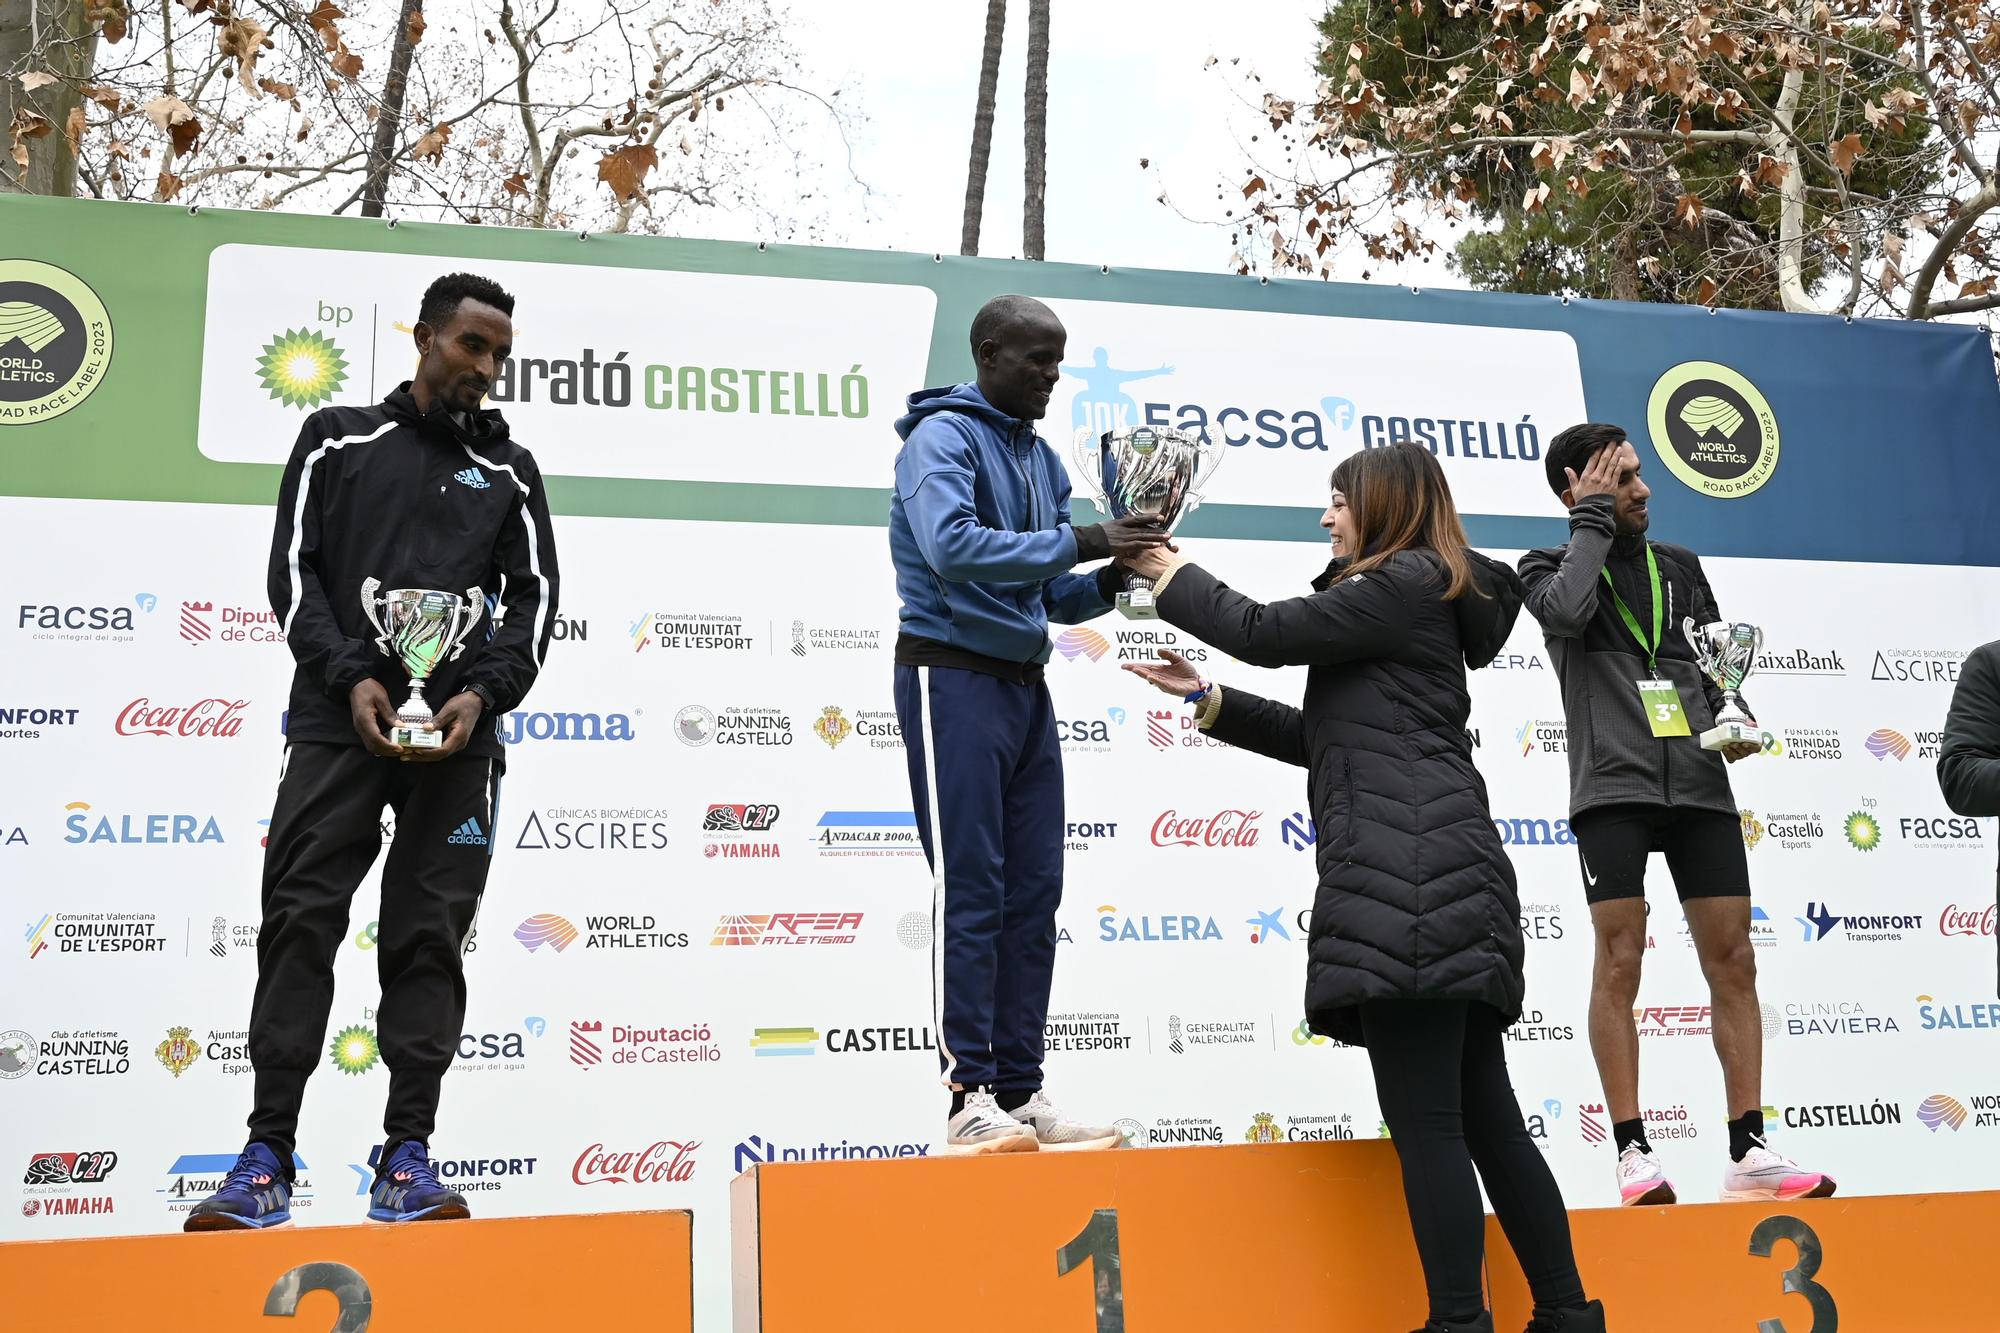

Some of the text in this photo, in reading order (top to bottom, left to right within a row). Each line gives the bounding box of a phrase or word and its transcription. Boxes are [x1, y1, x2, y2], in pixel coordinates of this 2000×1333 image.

[318, 300, 353, 328] bp
[0, 357, 43, 370] ORLD
[28, 321, 105, 416] RACE LABEL 2023
[0, 370, 56, 383] LETICS
[487, 348, 869, 419] arató CASTELLÓ
[1361, 414, 1540, 461] CASTELLÓ
[1697, 442, 1736, 453] WORLD
[1703, 412, 1775, 493] ROAD RACE LABEL 2023
[1690, 452, 1747, 464] ATHLETICS
[454, 473, 491, 489] adidas
[18, 605, 134, 631] Facsa
[222, 607, 276, 626] Diput
[655, 612, 741, 622] Comunitat Valenciana
[221, 626, 245, 641] de
[655, 622, 742, 636] COMUNITAT
[809, 629, 880, 639] GENERALITAT
[661, 636, 682, 648] DE
[811, 640, 879, 650] VALENCIANA
[1116, 631, 1177, 645] WORLD
[1117, 647, 1208, 662] ATHLTICS
[1757, 648, 1845, 671] aixaBank
[1888, 648, 1921, 658] CLÍNICAS
[1871, 650, 1959, 682] ASCIRE
[0, 708, 79, 725] NFORT
[115, 698, 251, 737] Coca-Cola
[726, 706, 741, 715] Club
[856, 710, 897, 720] Ajuntame
[717, 716, 791, 731] RUNNING
[856, 720, 902, 736] Caste
[1056, 720, 1110, 742] csa
[716, 728, 793, 746] CASTELLÓ
[1785, 728, 1839, 736] FUNDACIÓN
[871, 739, 905, 750] Esports
[1182, 733, 1202, 747] de
[1543, 742, 1559, 752] DE
[1785, 738, 1840, 749] TRINIDAD
[1788, 749, 1842, 760] ALFONSO
[1861, 795, 1877, 808] bp
[547, 806, 668, 819] CLÍNICAS BIOMÉDICAS
[742, 804, 779, 830] C2P
[1766, 812, 1821, 822] Ajuntament de
[64, 814, 225, 843] SALERA
[1066, 823, 1117, 838] FORT
[1150, 810, 1264, 847] Coca-Cola
[1768, 822, 1824, 839] Castelló
[1900, 817, 1982, 839] Facsa
[447, 833, 488, 845] adidas
[818, 828, 882, 845] ANDACAR
[721, 844, 780, 858] YAMAHA
[1781, 840, 1811, 850] Esports
[56, 912, 155, 921] Comunitat Valenciana
[586, 916, 655, 930] WORLD
[768, 912, 864, 935] RFEA
[1843, 916, 1923, 929] MONFORT
[54, 923, 155, 937] COMUNITAT
[1100, 916, 1223, 942] SALERA
[1846, 931, 1902, 942] Transportes
[61, 940, 82, 952] DE
[586, 933, 689, 949] ATHLETICS
[761, 935, 856, 945] ATLETISMO
[1077, 1012, 1120, 1021] Valenciana
[1785, 1002, 1865, 1016] CLINICA
[1919, 1004, 2000, 1030] SALER
[1044, 1022, 1120, 1036] OMUNITAT
[1186, 1022, 1255, 1034] GENERALITAT
[1506, 1026, 1573, 1041] HLETICS
[1788, 1017, 1900, 1035] BAVIERA
[51, 1030, 69, 1039] Club
[208, 1030, 250, 1041] Ajuntam
[612, 1024, 711, 1046] Diputació
[826, 1028, 936, 1052] CASTELL
[1188, 1034, 1255, 1044] VALENCIANA
[40, 1039, 129, 1057] RUNNING
[206, 1042, 250, 1060] Cast
[457, 1033, 525, 1059] csa
[612, 1044, 721, 1064] de Castelló
[37, 1053, 130, 1076] CASTELLÓ
[222, 1063, 253, 1076] Espor
[1287, 1113, 1352, 1126] Ajuntament de
[1784, 1098, 1902, 1128] CASTELLÓN
[1157, 1118, 1172, 1127] Club
[1149, 1127, 1223, 1143] RUNNING
[1288, 1124, 1353, 1141] Castelló
[71, 1152, 117, 1182] C2P
[572, 1140, 703, 1186] Coca-Cola
[44, 1197, 114, 1216] YAMAHA
[1748, 1214, 1838, 1333] 3
